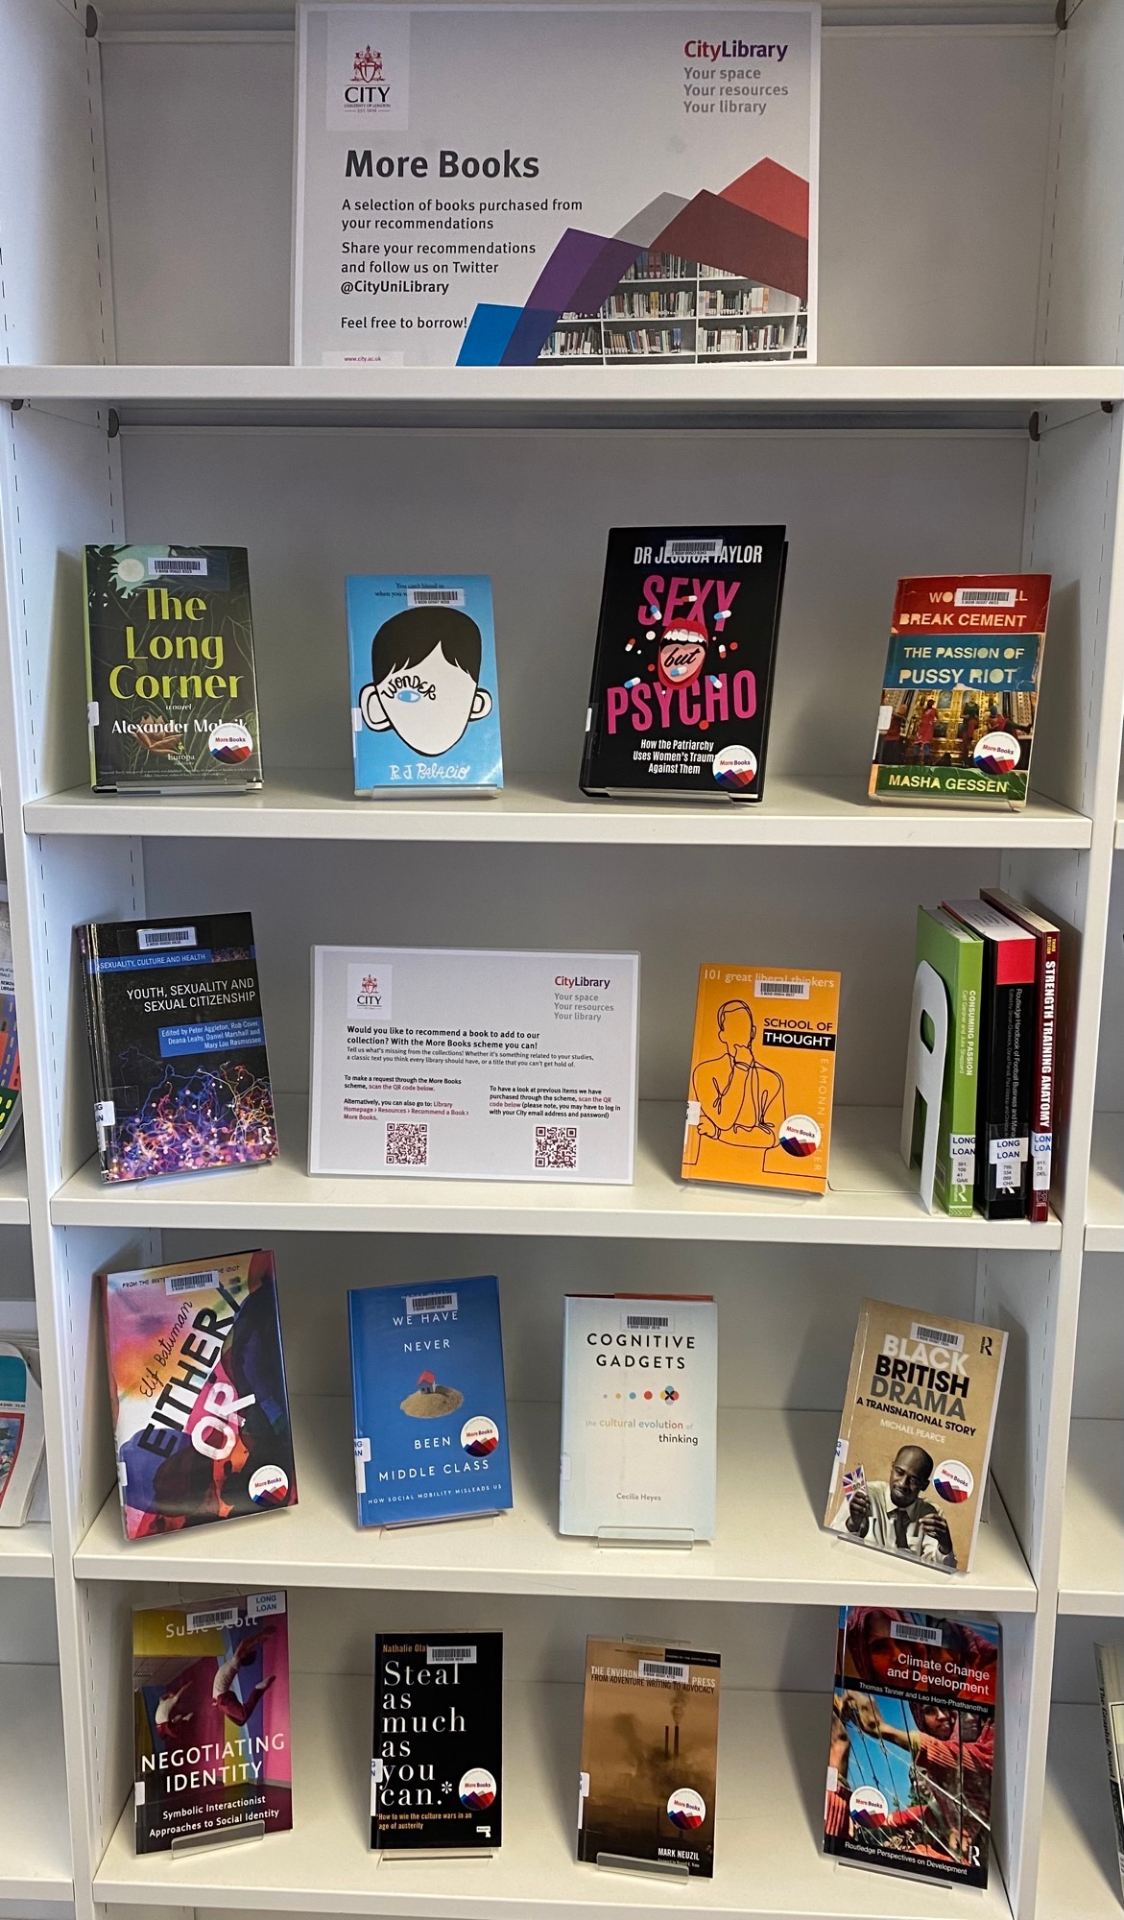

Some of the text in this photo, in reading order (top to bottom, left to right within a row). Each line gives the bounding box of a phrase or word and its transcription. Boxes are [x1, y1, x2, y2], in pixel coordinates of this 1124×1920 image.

[684, 40, 788, 62] CityLibrary
[684, 67, 761, 82] Your space
[344, 87, 390, 103] CITY
[684, 84, 788, 96] Your resources
[684, 100, 766, 115] Your library
[345, 149, 539, 178] More Books
[342, 199, 582, 213] A selection of books purchased from
[342, 217, 493, 231] your recommendations
[342, 242, 536, 256] Share your recommendations
[342, 261, 498, 273] and follow us on Twitter
[341, 281, 449, 295] @CityUniLibrary
[342, 317, 467, 328] Feel free to borrow!
[634, 547, 651, 564] DR
[139, 587, 207, 620] The
[638, 575, 741, 631] SEXY
[900, 613, 1026, 627] BREAK CEMENT
[125, 626, 224, 670] Long
[904, 647, 1024, 659] THE PASSION OF
[664, 648, 700, 667] but
[109, 665, 245, 700] Corner
[900, 669, 1017, 684] PUSSY RIOT
[607, 670, 756, 734] PSYCHO
[112, 720, 189, 734] Alexander
[641, 740, 713, 752] How the Patriarchy
[648, 763, 700, 774] Against Them
[889, 775, 1008, 793] MASHA GESSEN
[137, 958, 165, 967] CULTURE
[127, 978, 254, 1000] YOUTH, SEXUALITY AND
[555, 976, 610, 989] CityLibrary
[144, 991, 255, 1012] SEXUAL CITIZENSHIP
[357, 996, 381, 1004] CITY
[347, 1026, 371, 1034] Would
[764, 1017, 832, 1031] SCHOOL OF
[765, 1032, 832, 1047] THOUGHT
[966, 991, 976, 1076] CONSUMING PASSION
[347, 1037, 389, 1045] collection?
[505, 1042, 519, 1050] you
[1040, 960, 1056, 1127] STRENGTH TRAINING ANATOMY
[393, 1312, 458, 1326] WE HAVE
[404, 1339, 450, 1352] NEVER
[587, 1333, 695, 1349] COGNITIVE
[596, 1354, 685, 1369] GADGETS
[882, 1334, 969, 1375] BLACK
[875, 1355, 970, 1398] BRITISH
[870, 1375, 966, 1421] DRAMA
[192, 1382, 256, 1460] OR
[857, 1396, 976, 1436] A TRANSNATIONAL STORY
[880, 1419, 945, 1443] MICHAEL PEARCE
[415, 1438, 451, 1449] BEEN
[659, 1434, 698, 1446] thinking
[379, 1460, 489, 1481] MIDDLE CLASS
[418, 1491, 451, 1499] MOBILITY
[256, 1594, 276, 1603] LONG
[256, 1603, 277, 1612] LOAN
[384, 1661, 461, 1686] Steal
[898, 1653, 990, 1681] Climate Change
[692, 1677, 715, 1687] PRESS
[888, 1668, 989, 1696] and Development
[383, 1692, 412, 1709] as
[382, 1707, 466, 1733] much
[141, 1733, 285, 1773] NEGOTIATING
[382, 1740, 411, 1757] as
[166, 1761, 263, 1792] IDENTITY
[380, 1764, 435, 1790] you
[163, 1795, 265, 1820] Symbolic Interactionist
[150, 1808, 279, 1837] Approaches to Social Identity
[658, 1847, 699, 1860] MARK NEUZIL
[845, 1842, 875, 1855] Routledge
[876, 1849, 915, 1863] Perspectives
[927, 1860, 968, 1875] Development
